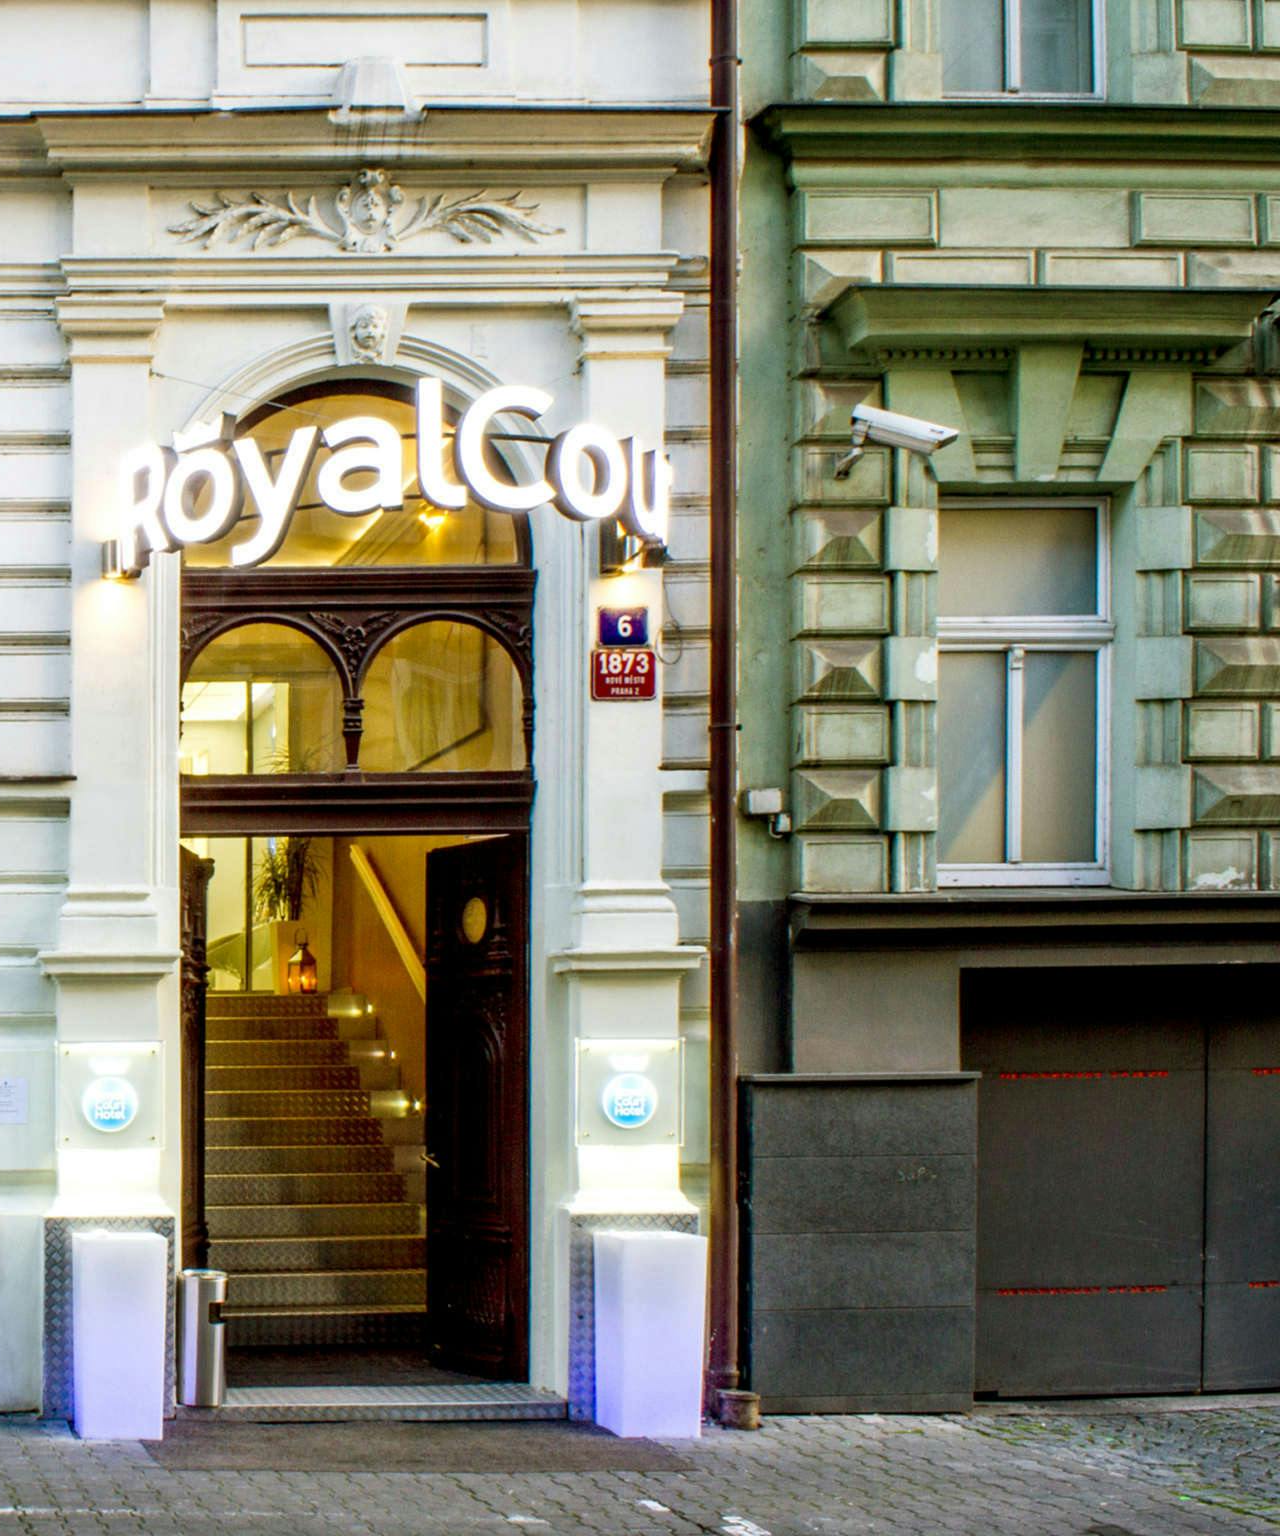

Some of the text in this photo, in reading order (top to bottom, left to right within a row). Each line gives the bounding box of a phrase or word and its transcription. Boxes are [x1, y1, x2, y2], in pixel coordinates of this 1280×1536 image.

[617, 615, 633, 638] 6
[599, 653, 649, 675] 1873
[610, 687, 641, 696] PRAHA 2
